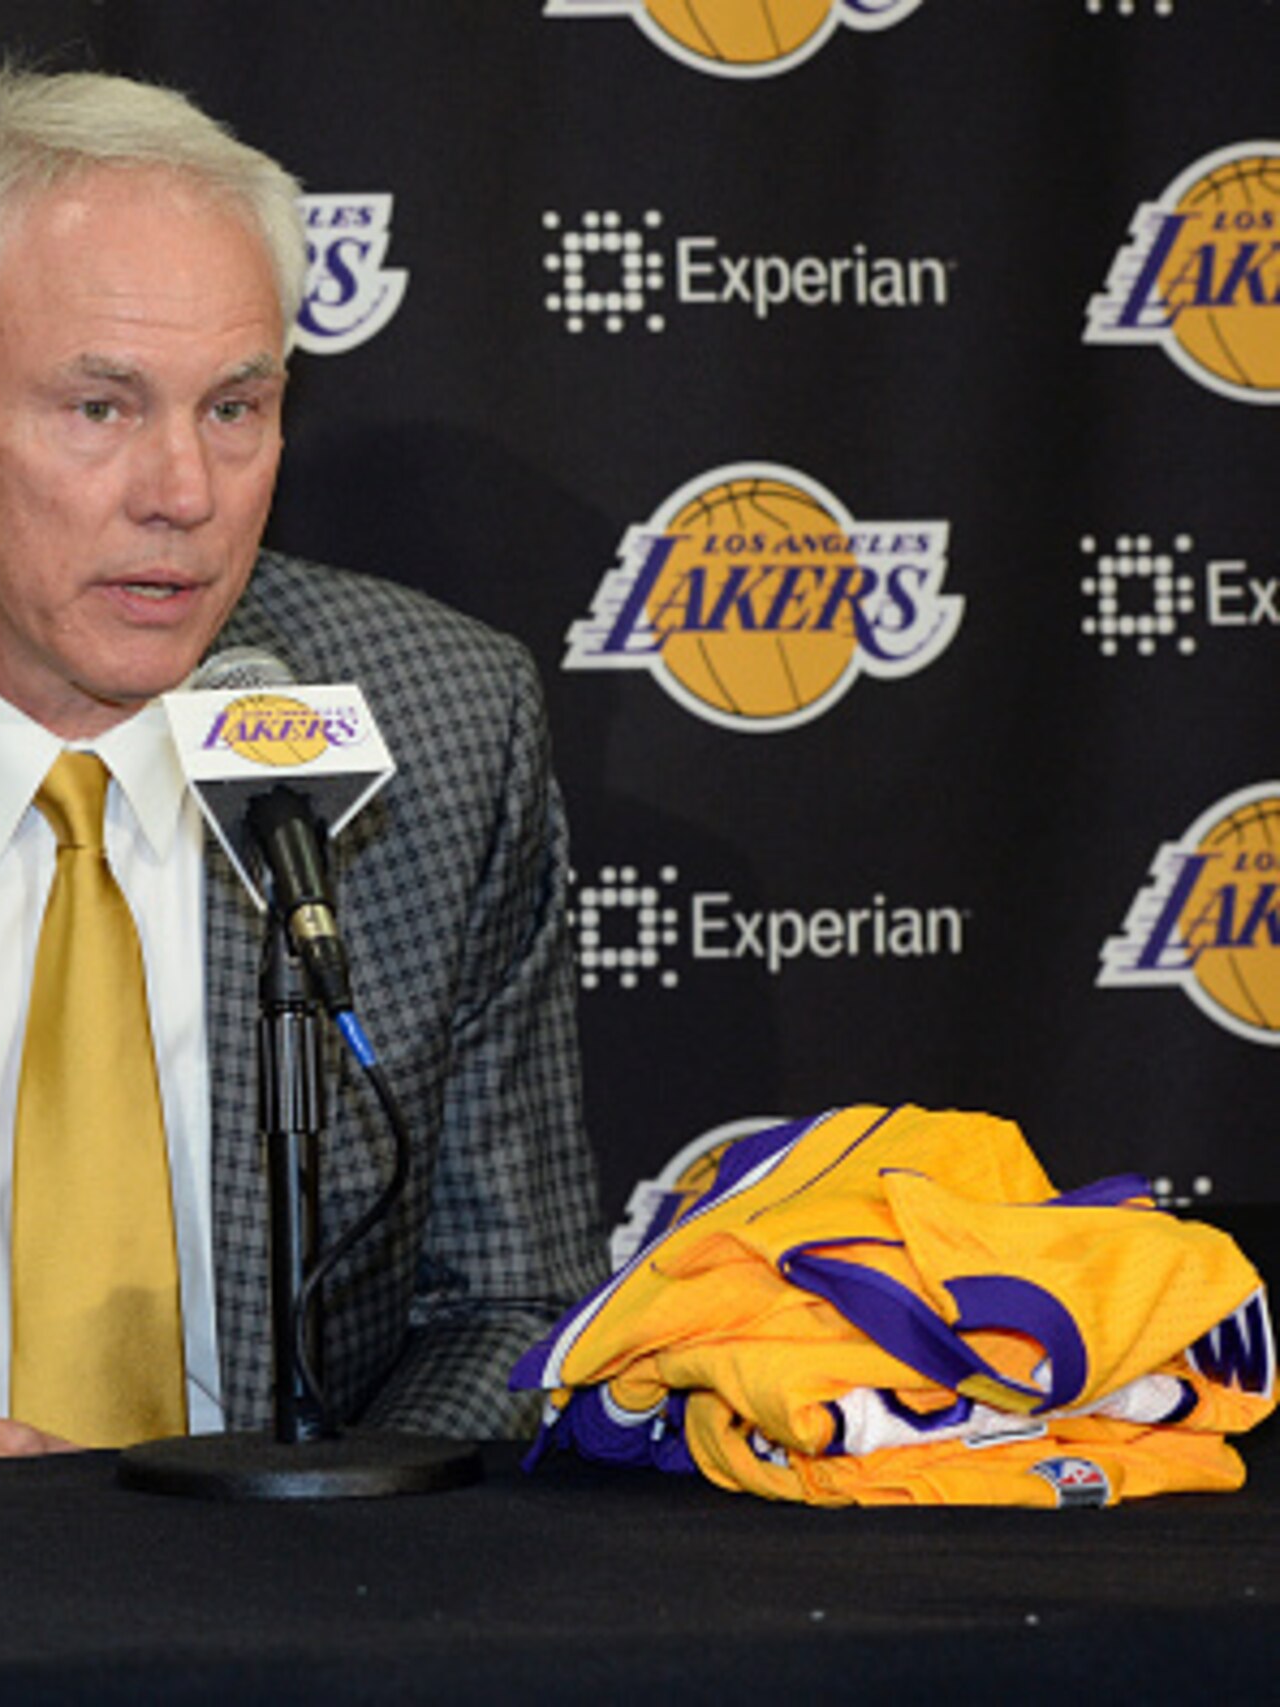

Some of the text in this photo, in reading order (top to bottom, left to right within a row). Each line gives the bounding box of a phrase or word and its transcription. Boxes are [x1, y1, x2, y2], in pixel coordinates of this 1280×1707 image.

[1212, 211, 1278, 231] LOS
[676, 238, 946, 318] Experian
[1100, 213, 1280, 328] LAK
[702, 533, 932, 556] LOS ANGELES
[584, 535, 947, 662] LAKERS
[203, 711, 370, 748] LAKERS
[1232, 852, 1280, 872] LO
[693, 894, 961, 973] Experian
[1116, 854, 1280, 970] LAK
